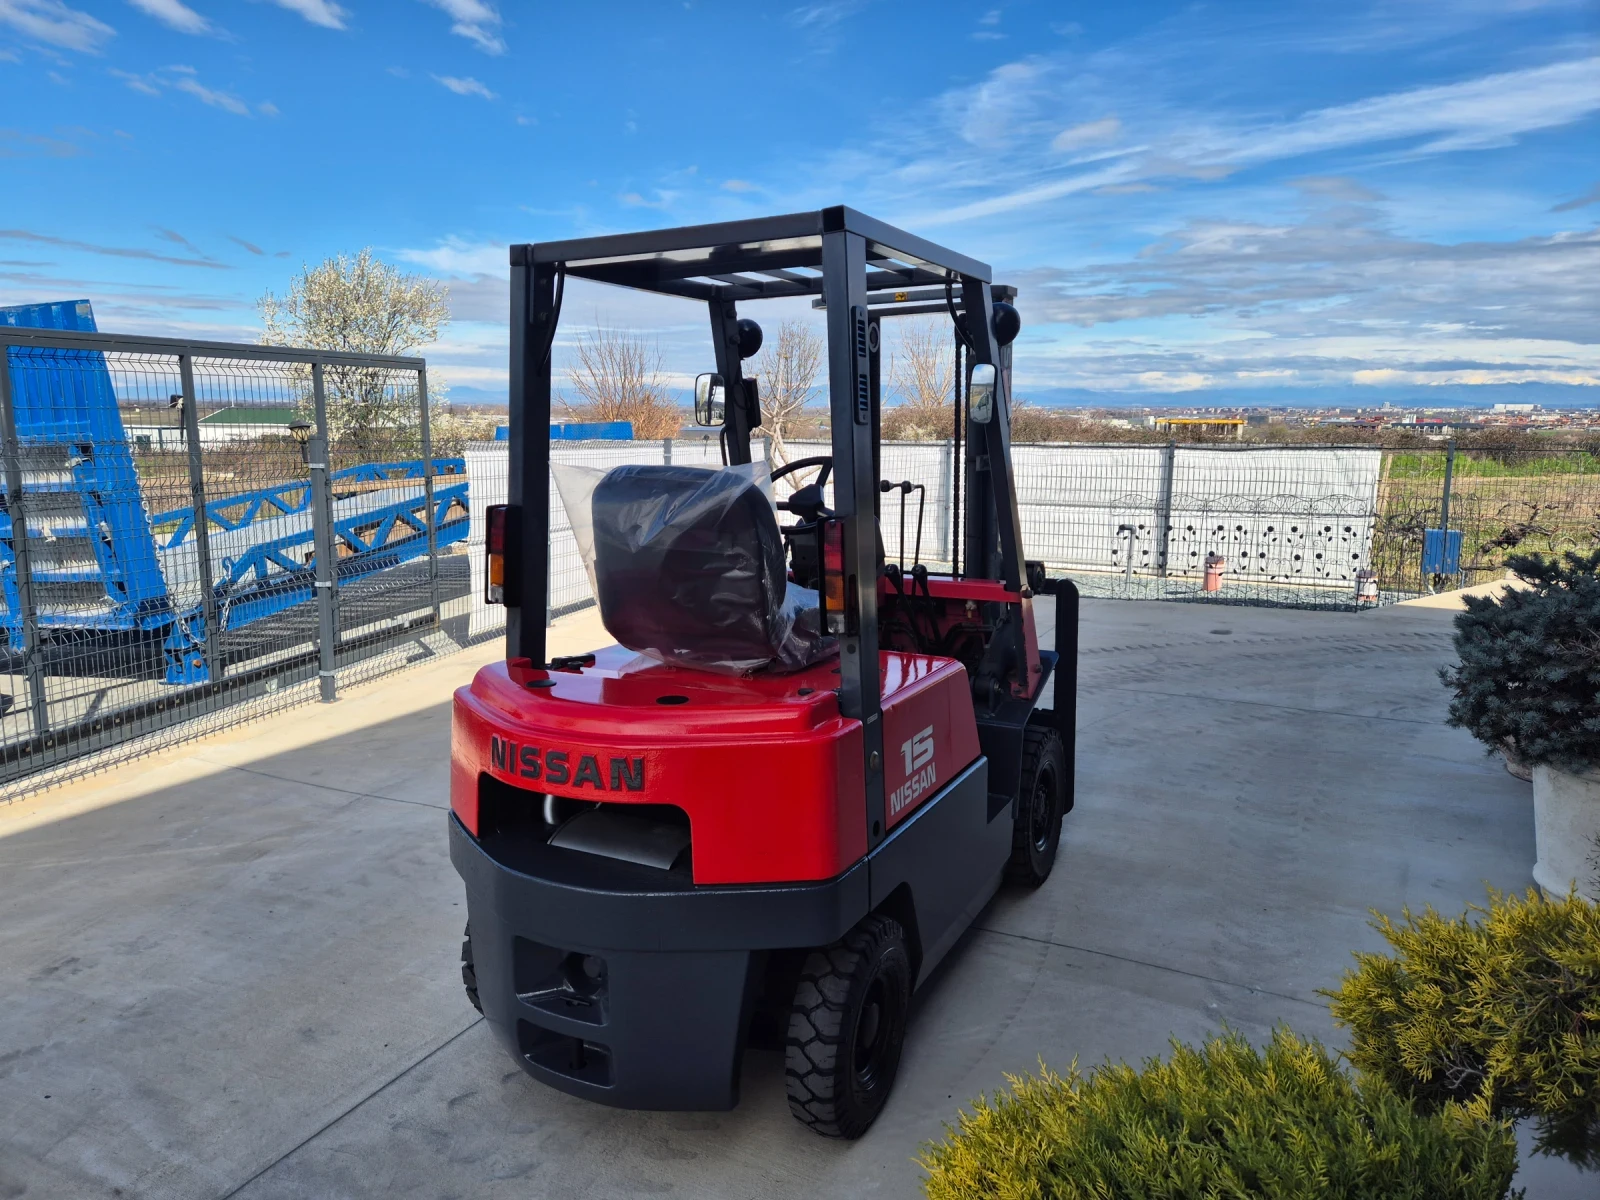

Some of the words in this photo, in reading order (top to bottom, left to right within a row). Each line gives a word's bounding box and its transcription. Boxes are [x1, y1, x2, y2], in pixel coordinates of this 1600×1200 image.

[491, 734, 645, 792] NISSAN
[900, 724, 934, 777] 15
[890, 761, 937, 817] NISSAN
